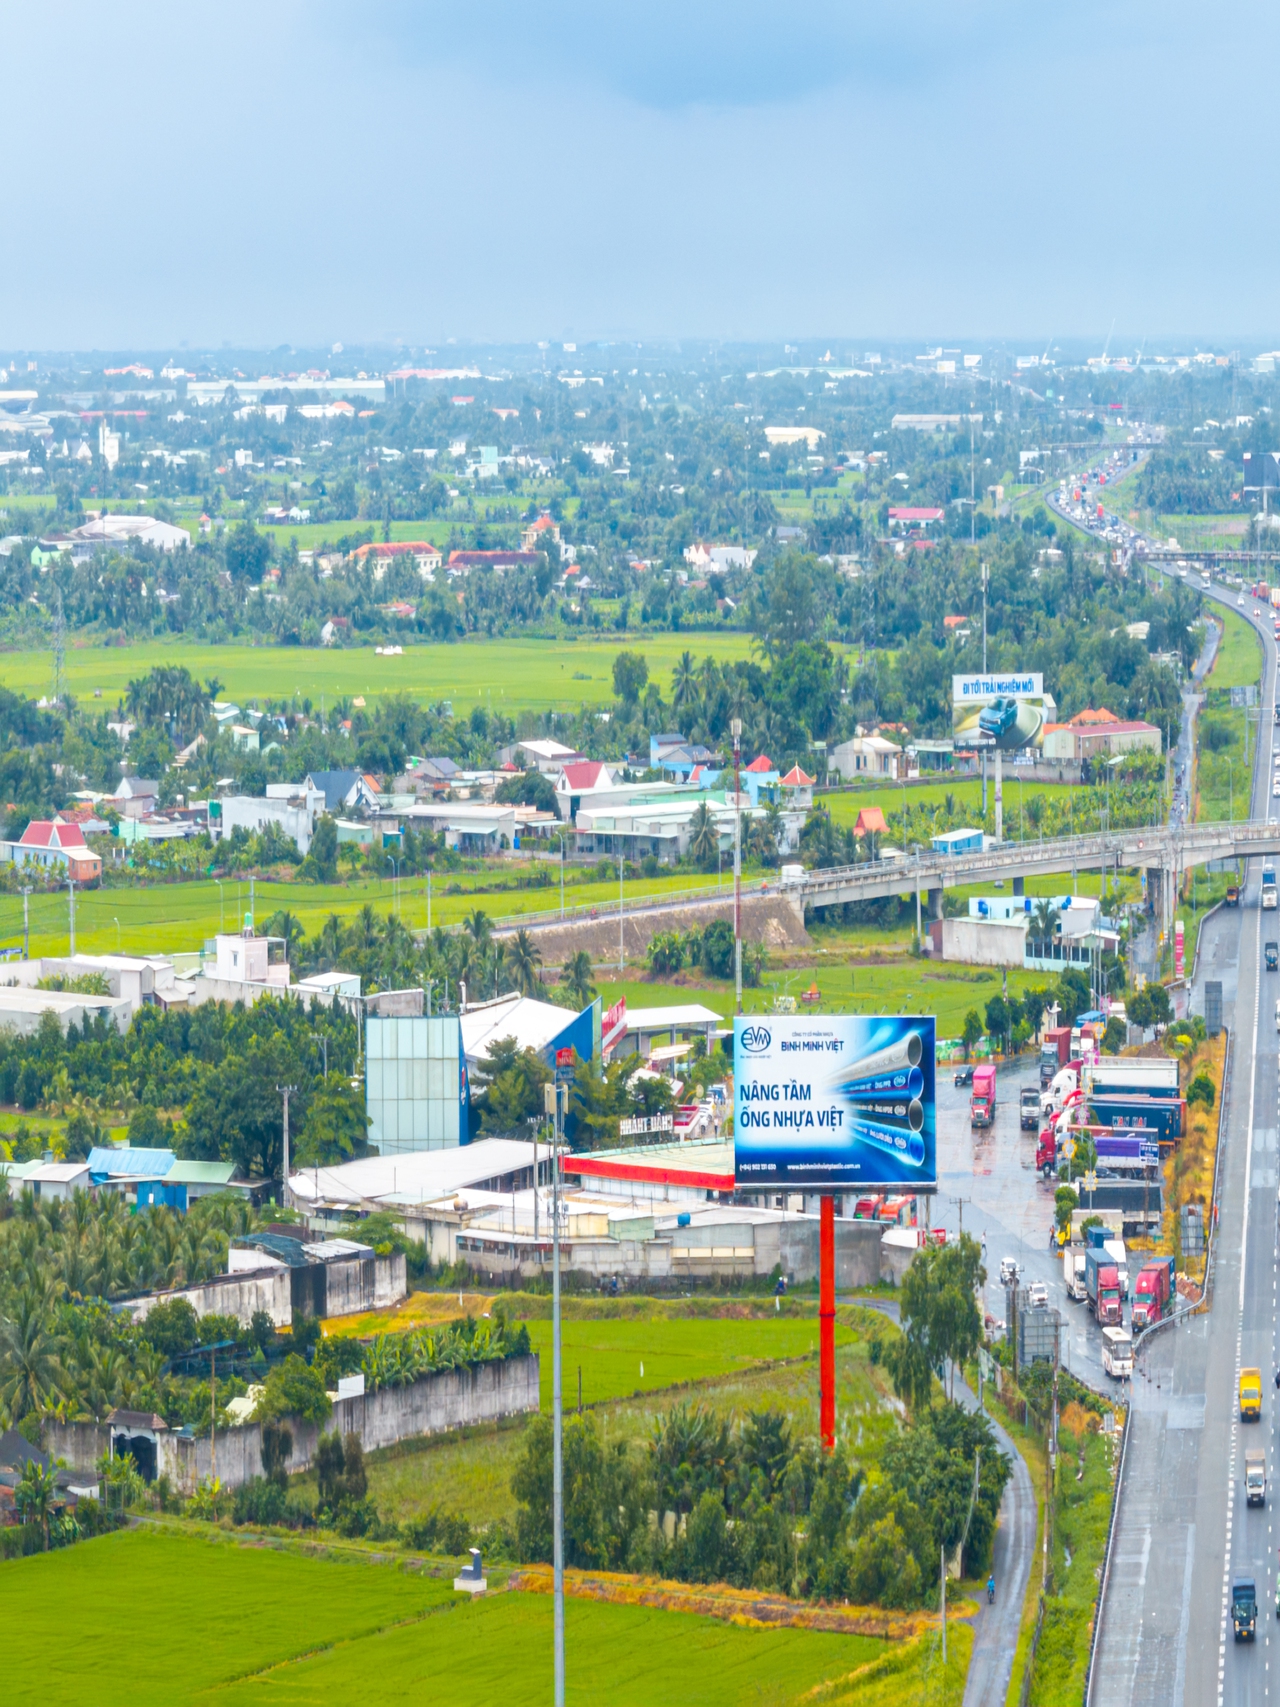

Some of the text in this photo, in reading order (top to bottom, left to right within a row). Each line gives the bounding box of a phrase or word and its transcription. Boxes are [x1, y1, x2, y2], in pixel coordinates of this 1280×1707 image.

[963, 683, 970, 694] ĐI
[982, 676, 996, 693] TRẢI
[997, 678, 1021, 696] NGHIỆM
[1022, 678, 1034, 692] MỚI
[825, 1038, 844, 1054] VIỆT
[740, 1078, 811, 1101] NÂNG TẦM
[740, 1105, 844, 1132] ỐNG NHỰA VIỆT
